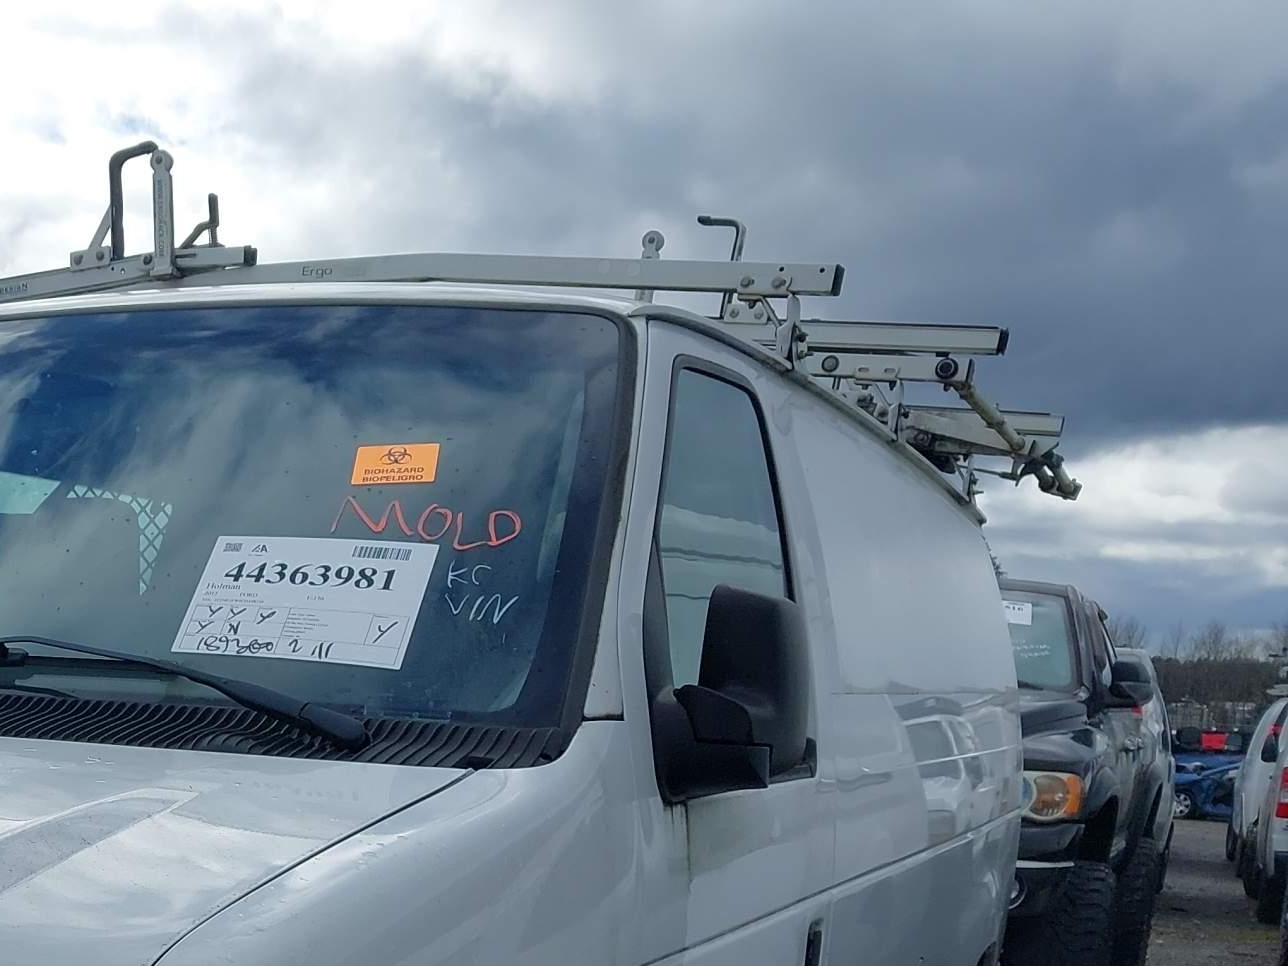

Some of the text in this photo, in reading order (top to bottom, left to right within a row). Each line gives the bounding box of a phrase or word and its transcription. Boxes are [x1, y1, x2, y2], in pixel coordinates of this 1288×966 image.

[302, 266, 332, 278] Ergo
[363, 466, 425, 475] BIOHAZARD
[362, 474, 424, 483] BIOPELIGRO
[329, 496, 521, 550] MOLD
[224, 561, 397, 592] 44363981
[206, 582, 241, 590] Holman
[444, 593, 519, 624] VIN
[227, 620, 241, 635] N
[372, 621, 400, 644] Y
